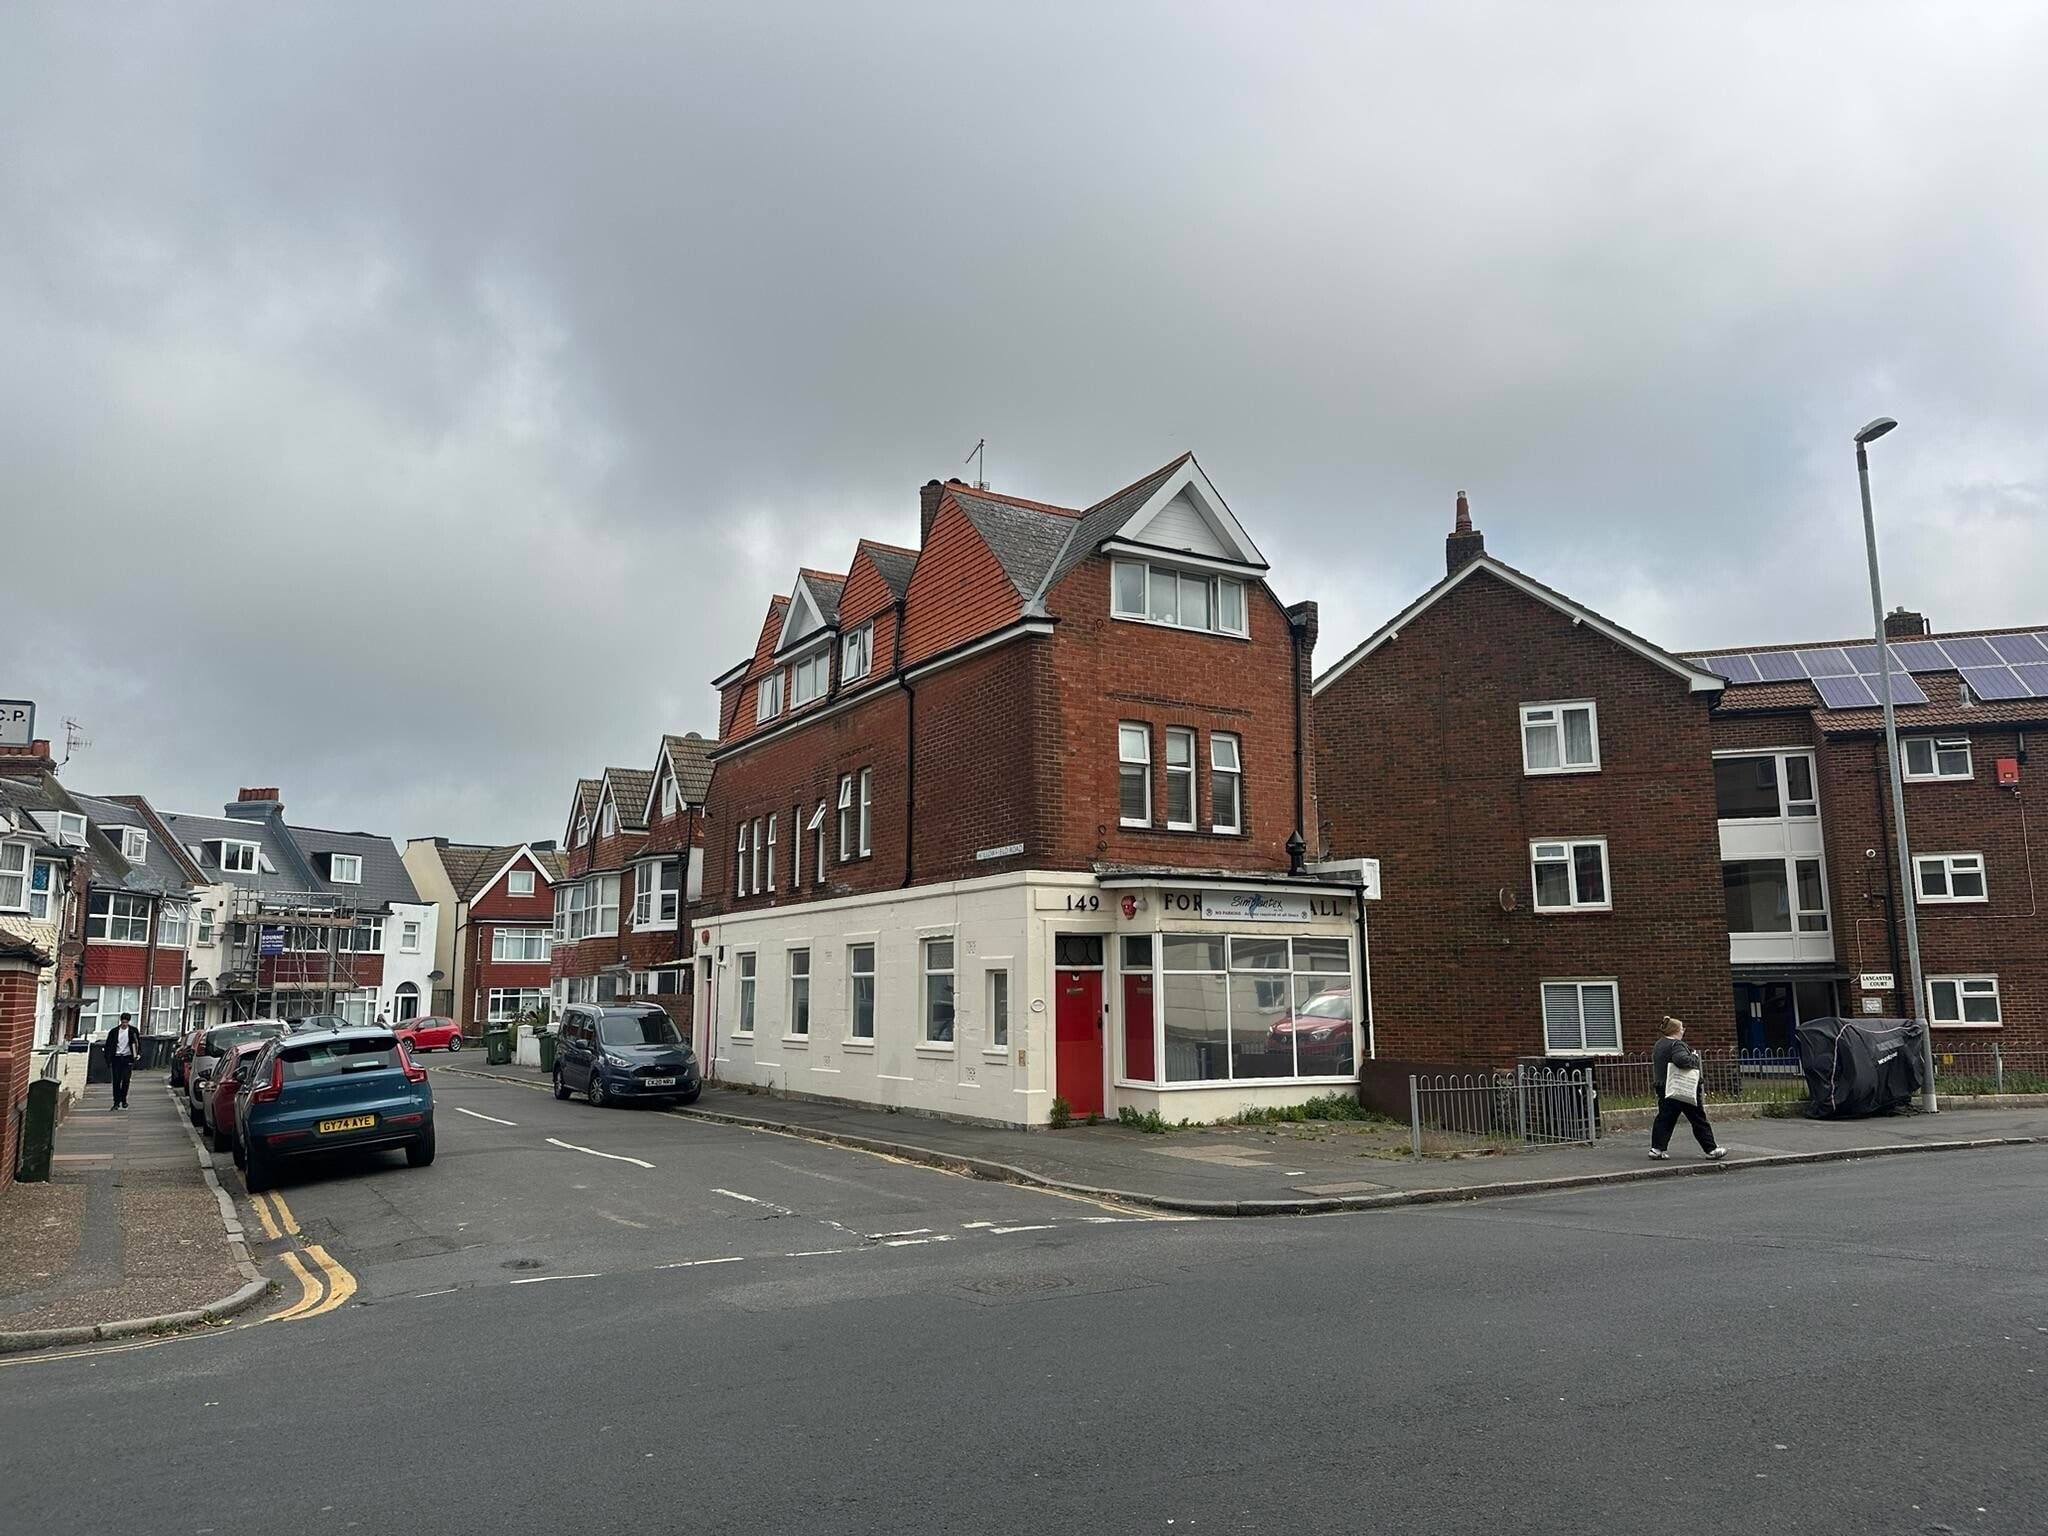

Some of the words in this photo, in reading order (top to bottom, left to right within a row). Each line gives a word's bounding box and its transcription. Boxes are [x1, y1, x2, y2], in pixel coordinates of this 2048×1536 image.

[1066, 895, 1099, 911] 149
[1164, 893, 1202, 911] FOR
[323, 1119, 350, 1132] GY74
[352, 1116, 371, 1128] AYE
